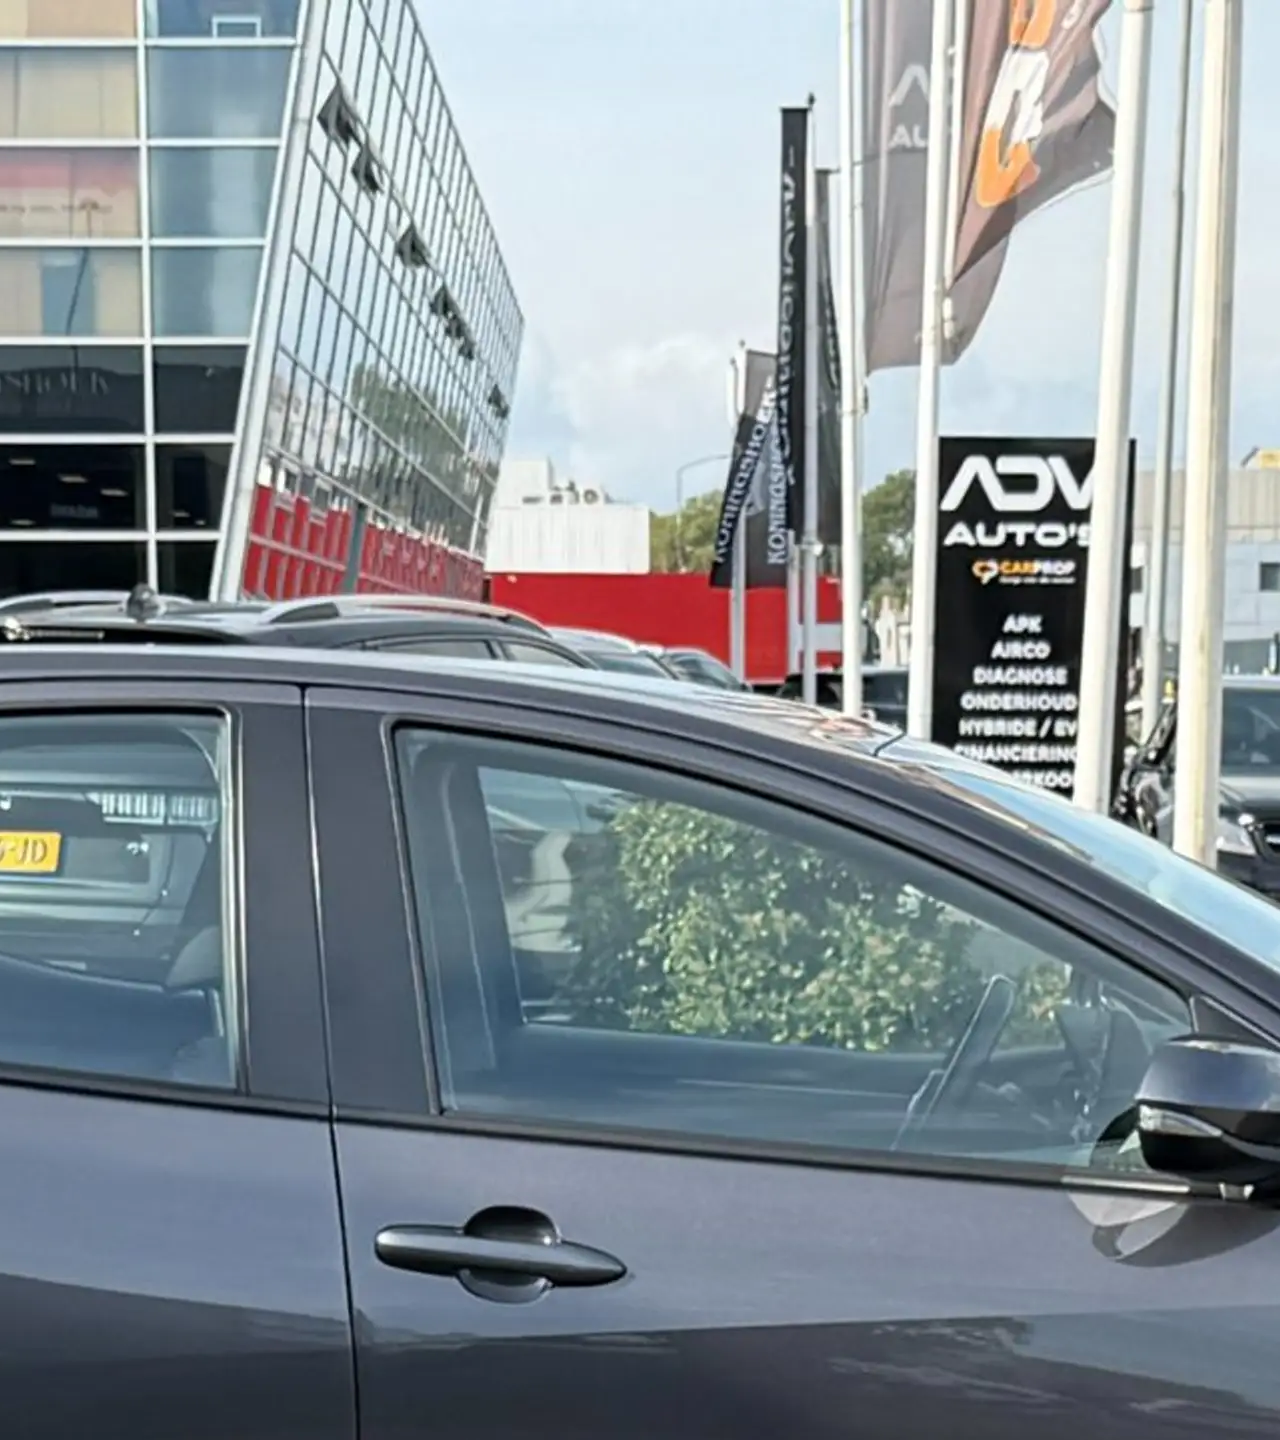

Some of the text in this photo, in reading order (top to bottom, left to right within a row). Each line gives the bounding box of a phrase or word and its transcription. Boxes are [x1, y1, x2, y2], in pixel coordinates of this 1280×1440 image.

[939, 455, 1094, 511] ADV
[1002, 615, 1043, 633] APK
[991, 641, 1051, 660] AIRCO
[973, 666, 1068, 685] DIAGNOSE
[960, 691, 1078, 711] ONDERHOUD
[958, 718, 1036, 737] HYBRIDE
